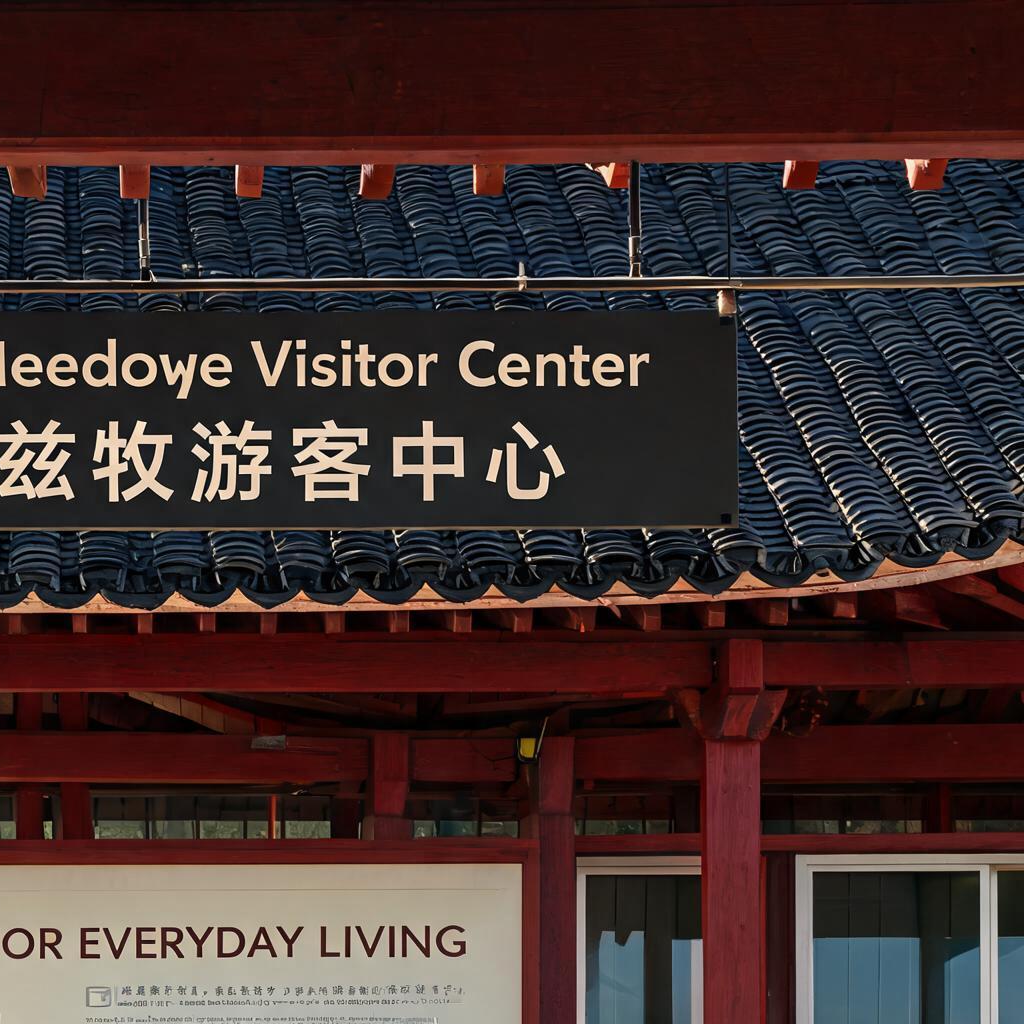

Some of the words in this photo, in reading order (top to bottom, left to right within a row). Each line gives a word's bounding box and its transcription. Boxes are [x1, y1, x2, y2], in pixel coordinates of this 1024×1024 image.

[251, 340, 438, 388] Visitor
[459, 340, 649, 388] Center
[80, 926, 305, 959] EVERYDAY
[321, 925, 467, 958] LIVING
